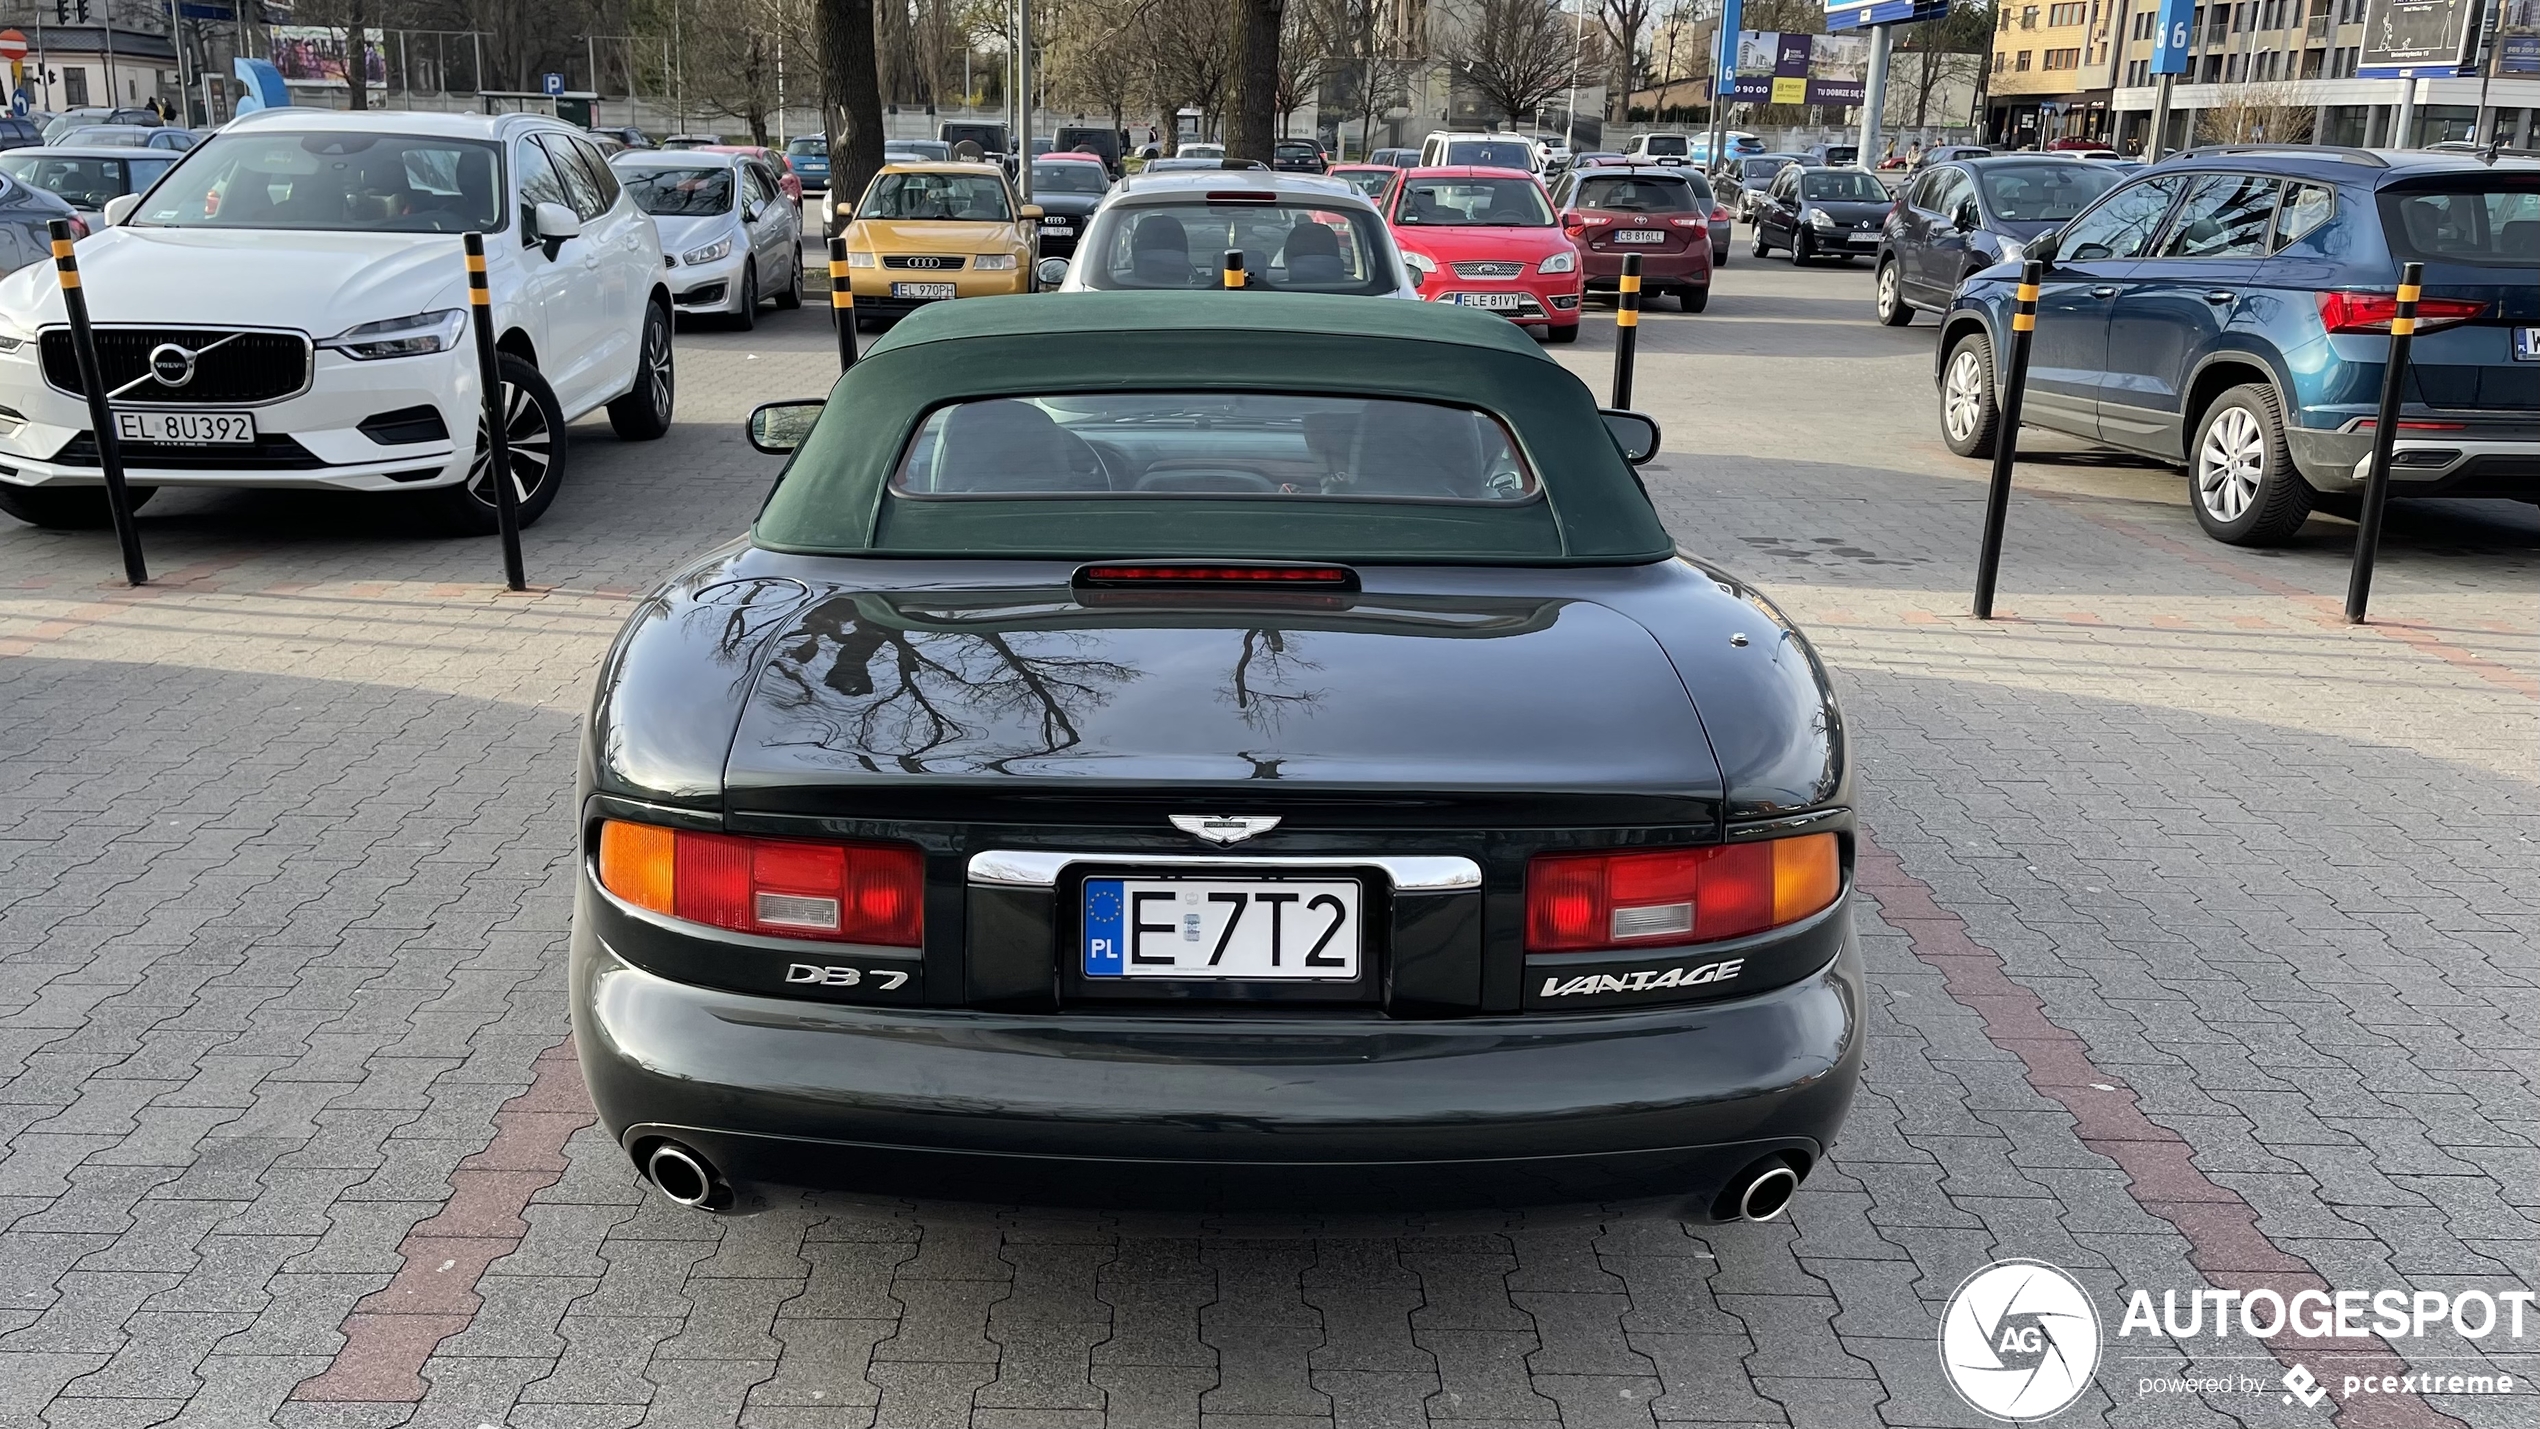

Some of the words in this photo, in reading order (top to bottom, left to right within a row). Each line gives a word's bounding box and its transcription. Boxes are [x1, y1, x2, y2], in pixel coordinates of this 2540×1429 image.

[2172, 22, 2186, 48] 6
[1725, 66, 1733, 80] 6
[547, 76, 560, 93] P
[1743, 85, 1754, 93] 90
[1826, 89, 1849, 97] DOBRZE
[960, 153, 978, 162] Jeep
[1620, 232, 1632, 240] CB
[1635, 231, 1661, 240] 816LL
[900, 284, 915, 296] EL
[919, 284, 953, 296] 970PH
[1463, 296, 1487, 306] ELE
[1491, 295, 1517, 306] 81VY
[155, 361, 186, 369] VOLVO
[120, 414, 155, 438] EL
[165, 415, 249, 440] 8U392
[1131, 891, 1176, 965] E
[1206, 892, 1347, 967] 7T2
[1091, 938, 1118, 959] PL
[1540, 958, 1745, 997] VANTAGE
